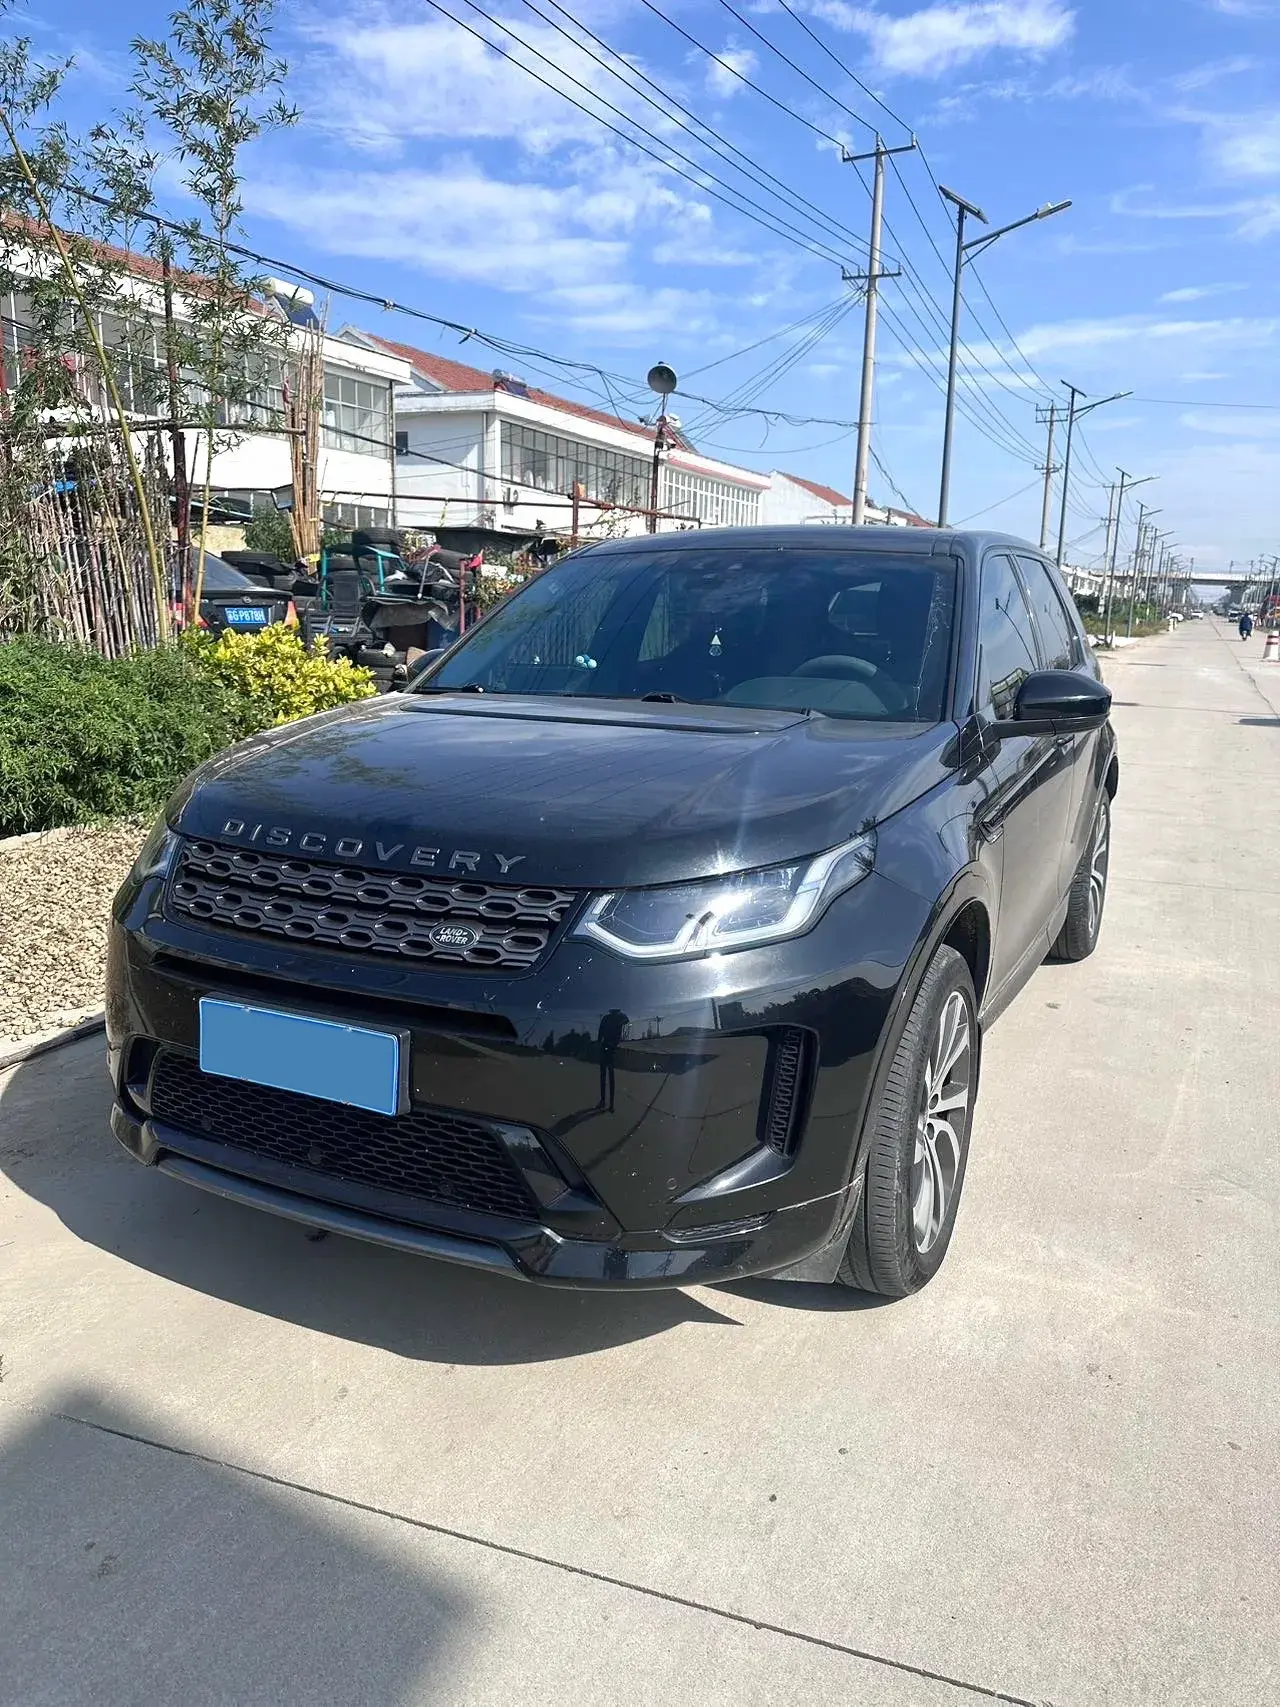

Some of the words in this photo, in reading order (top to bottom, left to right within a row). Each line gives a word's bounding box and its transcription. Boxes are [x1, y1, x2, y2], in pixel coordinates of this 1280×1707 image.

[221, 818, 526, 874] DISCOVERY
[440, 927, 463, 936] LAND
[439, 935, 468, 945] ROVER
